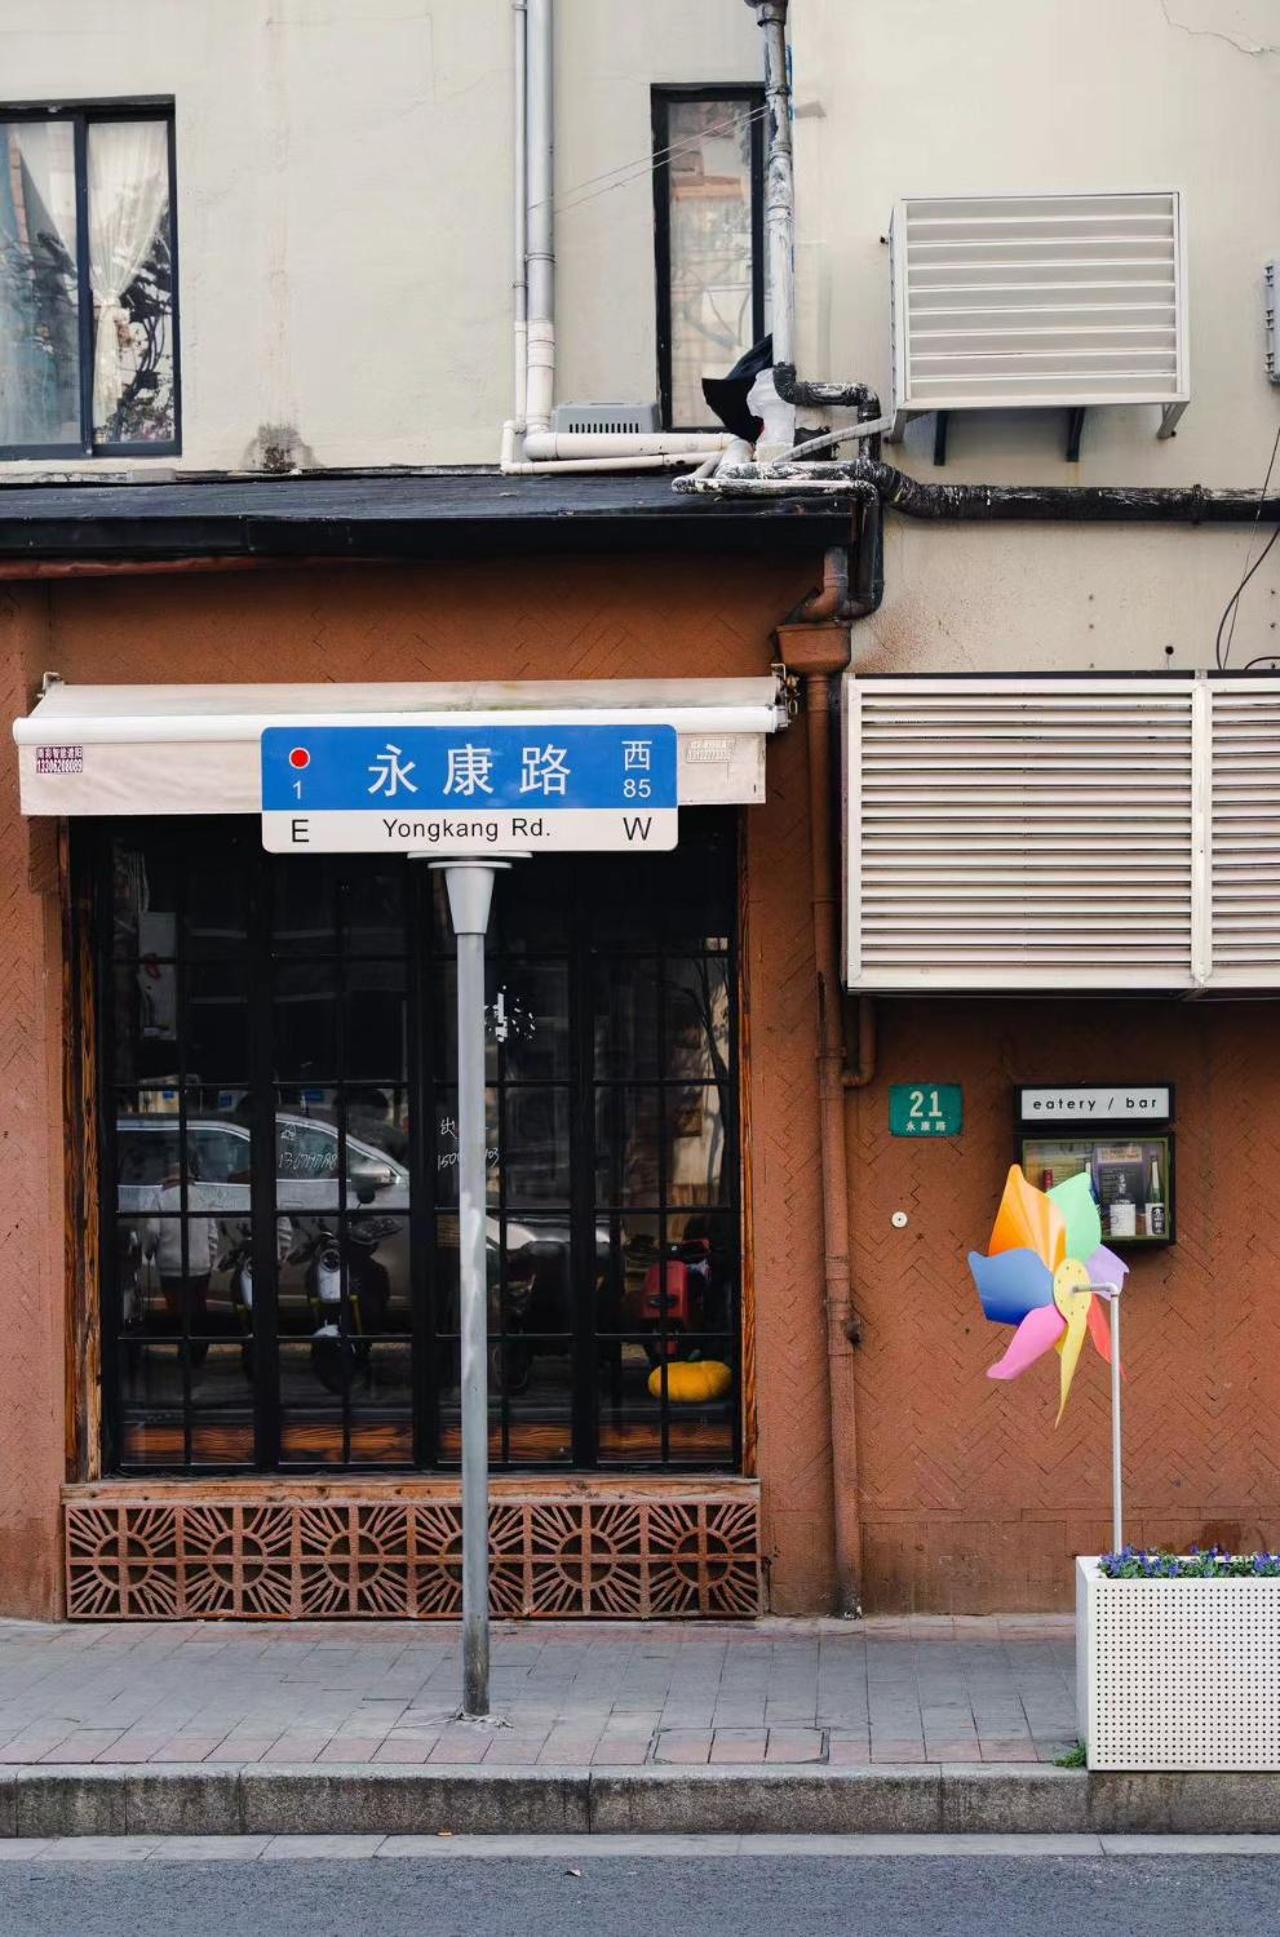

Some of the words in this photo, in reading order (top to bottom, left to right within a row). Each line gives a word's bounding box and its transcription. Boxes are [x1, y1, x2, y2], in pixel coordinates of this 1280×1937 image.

[622, 740, 652, 771] 西
[368, 743, 571, 797] 永康路
[292, 782, 303, 799] 1
[623, 778, 652, 798] 85
[291, 819, 310, 843] E
[383, 819, 498, 842] Yongkang
[512, 818, 551, 837] Rd.
[623, 817, 652, 841] W
[909, 1090, 942, 1117] 21
[1033, 1098, 1096, 1112] eatery
[1125, 1097, 1157, 1109] bar
